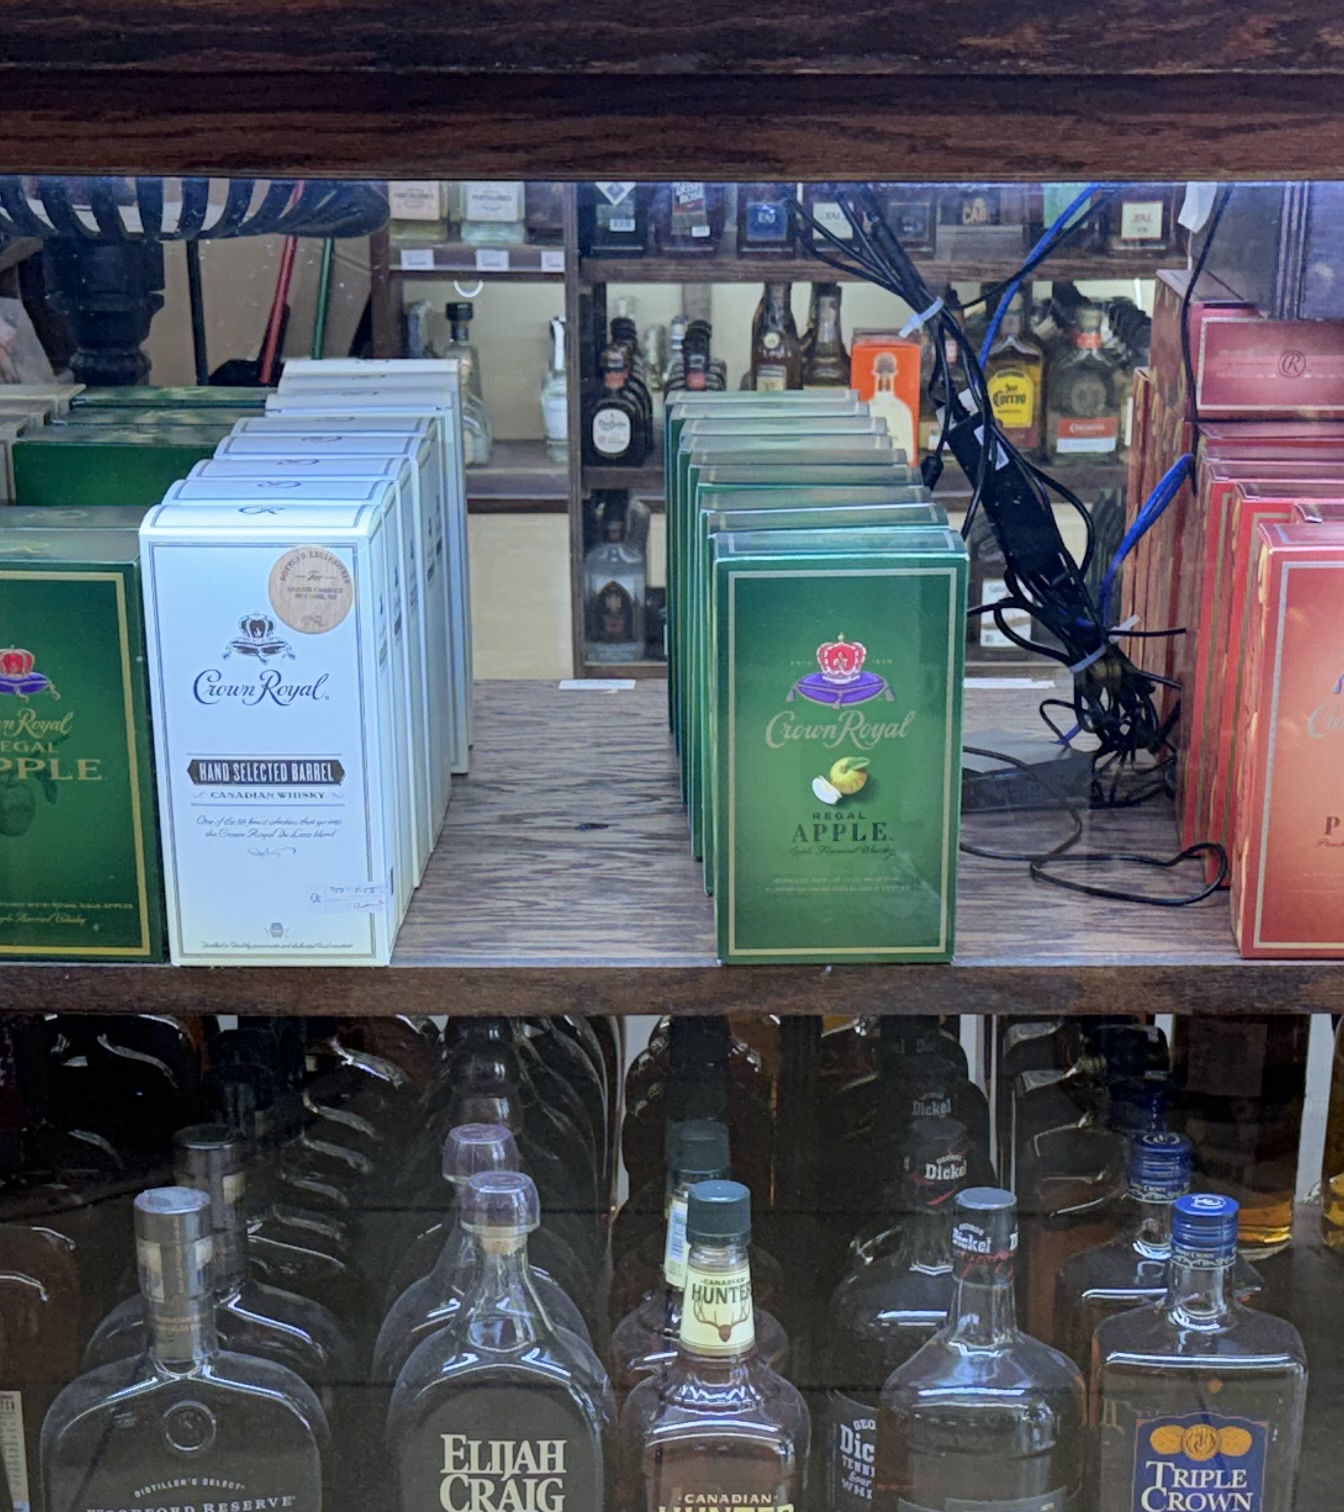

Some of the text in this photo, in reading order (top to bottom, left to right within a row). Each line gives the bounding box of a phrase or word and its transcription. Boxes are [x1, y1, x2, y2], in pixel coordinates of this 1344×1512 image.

[192, 668, 331, 707] Crown Royal
[1, 707, 75, 739] Royal
[764, 709, 917, 751] Crown Royal
[198, 762, 335, 783] HAND SELECTED BARREL
[209, 790, 326, 800] CANADIAN WHISKY
[812, 810, 867, 821] REGAL
[791, 821, 888, 843] APPLE
[924, 1159, 968, 1181] Dickel
[852, 1418, 877, 1432] GEO
[839, 1423, 877, 1463] Dic
[439, 1433, 568, 1482] ELIJAH
[1145, 1460, 1249, 1489] TRIPLE
[683, 1493, 773, 1505] CANADIAN
[840, 1478, 874, 1500] WHI
